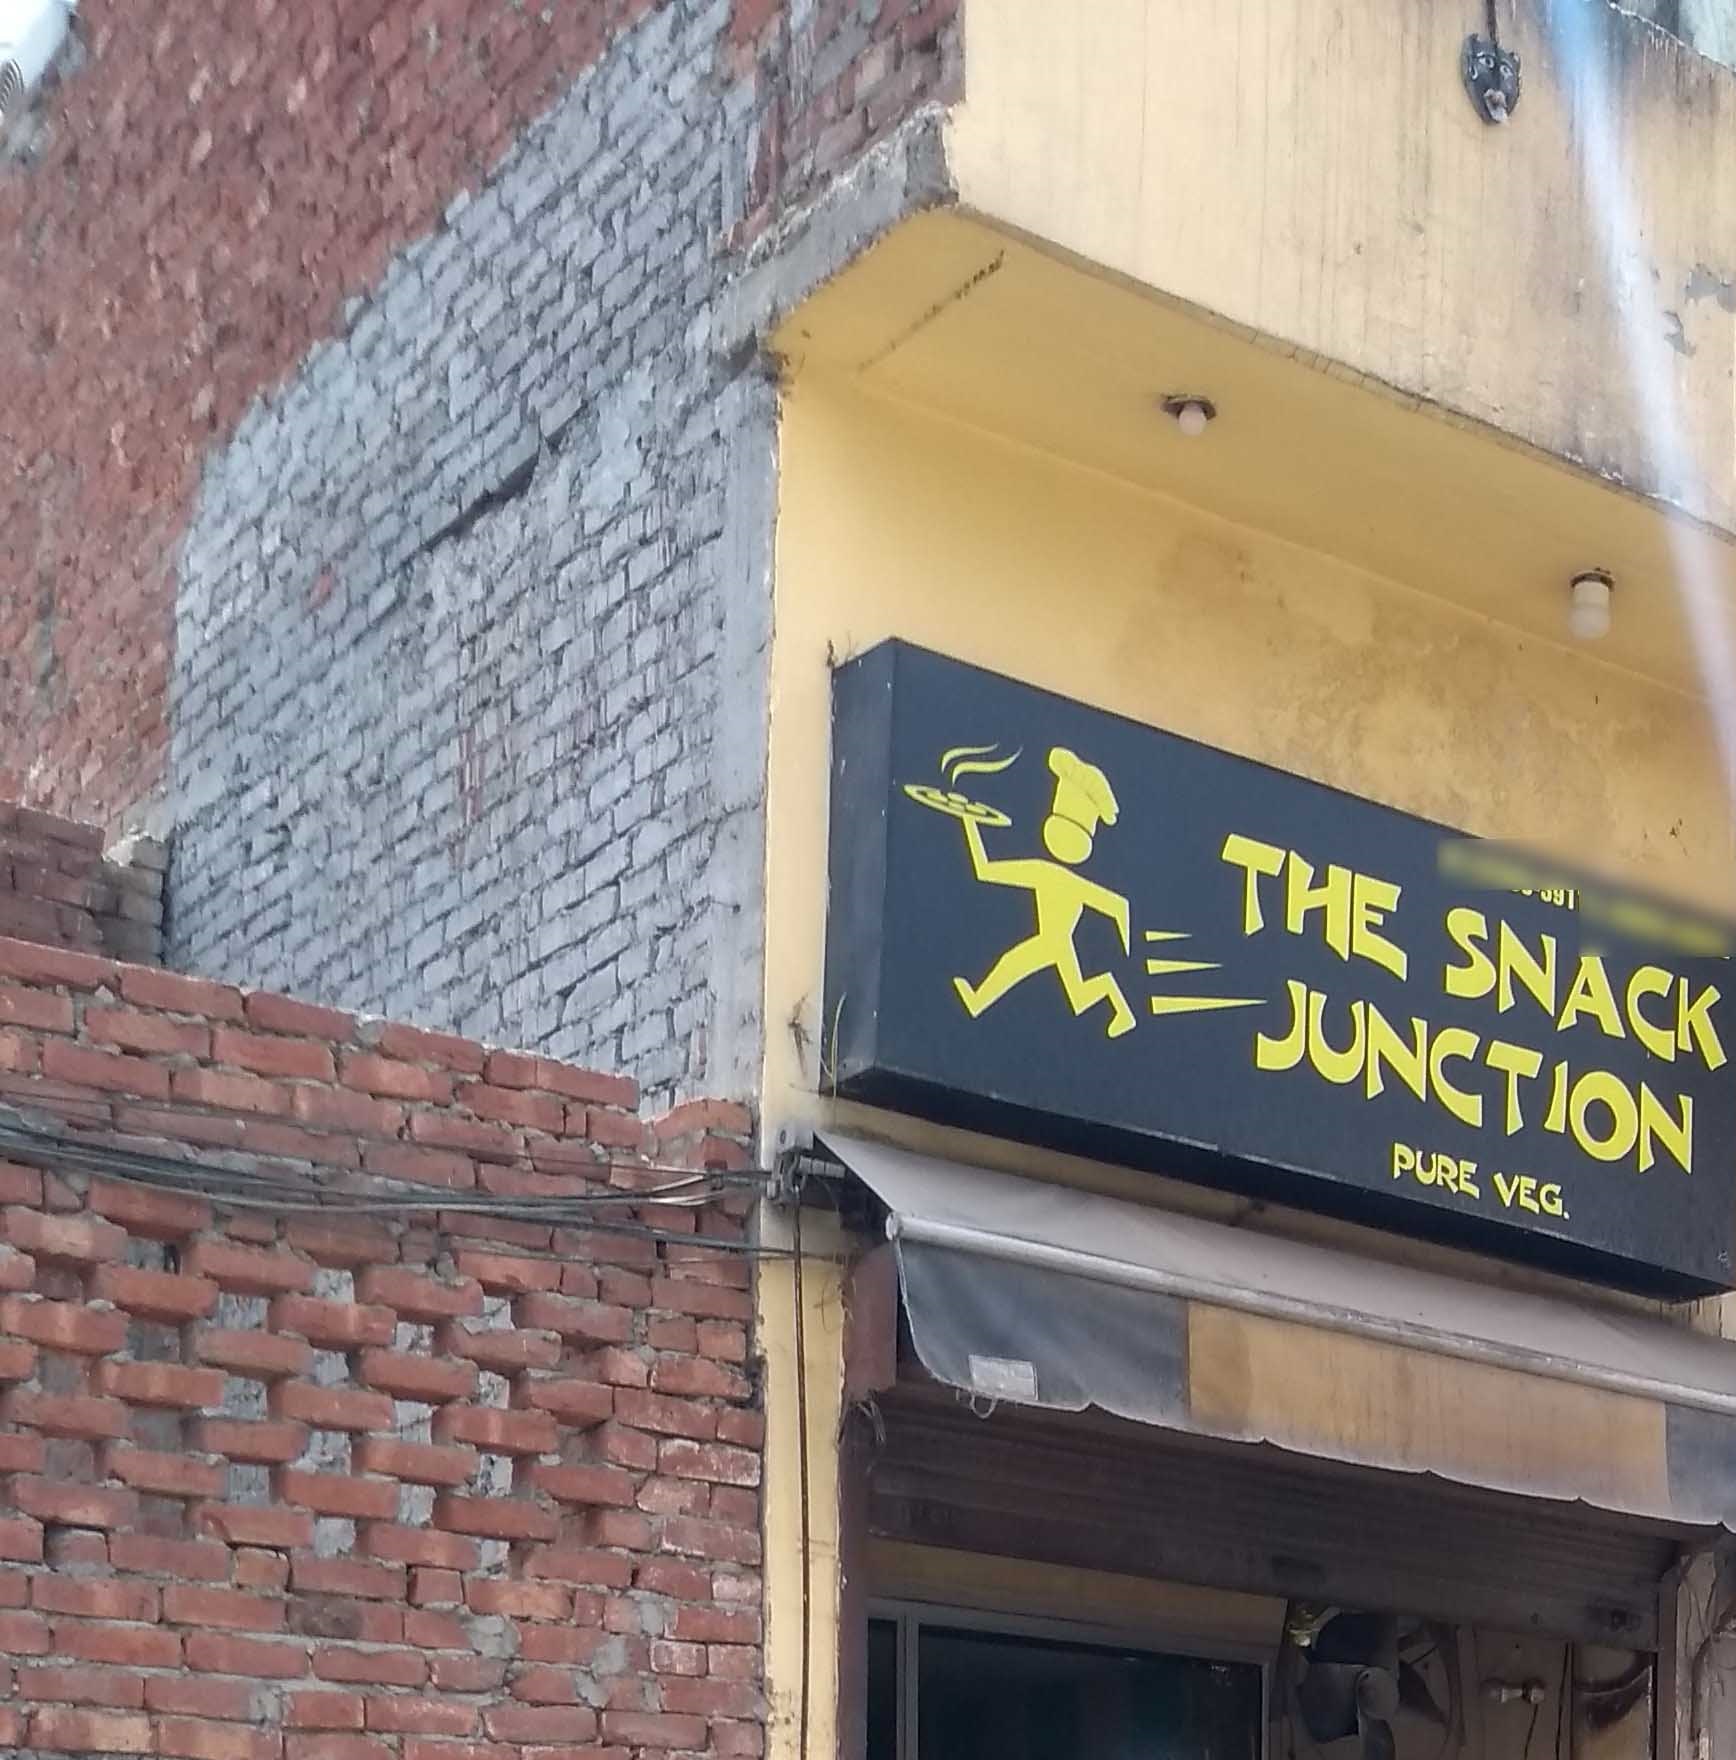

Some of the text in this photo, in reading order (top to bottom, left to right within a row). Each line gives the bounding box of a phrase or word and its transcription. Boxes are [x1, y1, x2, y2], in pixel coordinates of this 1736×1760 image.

[1221, 832, 1408, 983] THE
[1445, 907, 1729, 1072] SNACK
[1256, 979, 1694, 1175] JUNCTION
[1393, 1142, 1570, 1221] PURE VEG.
